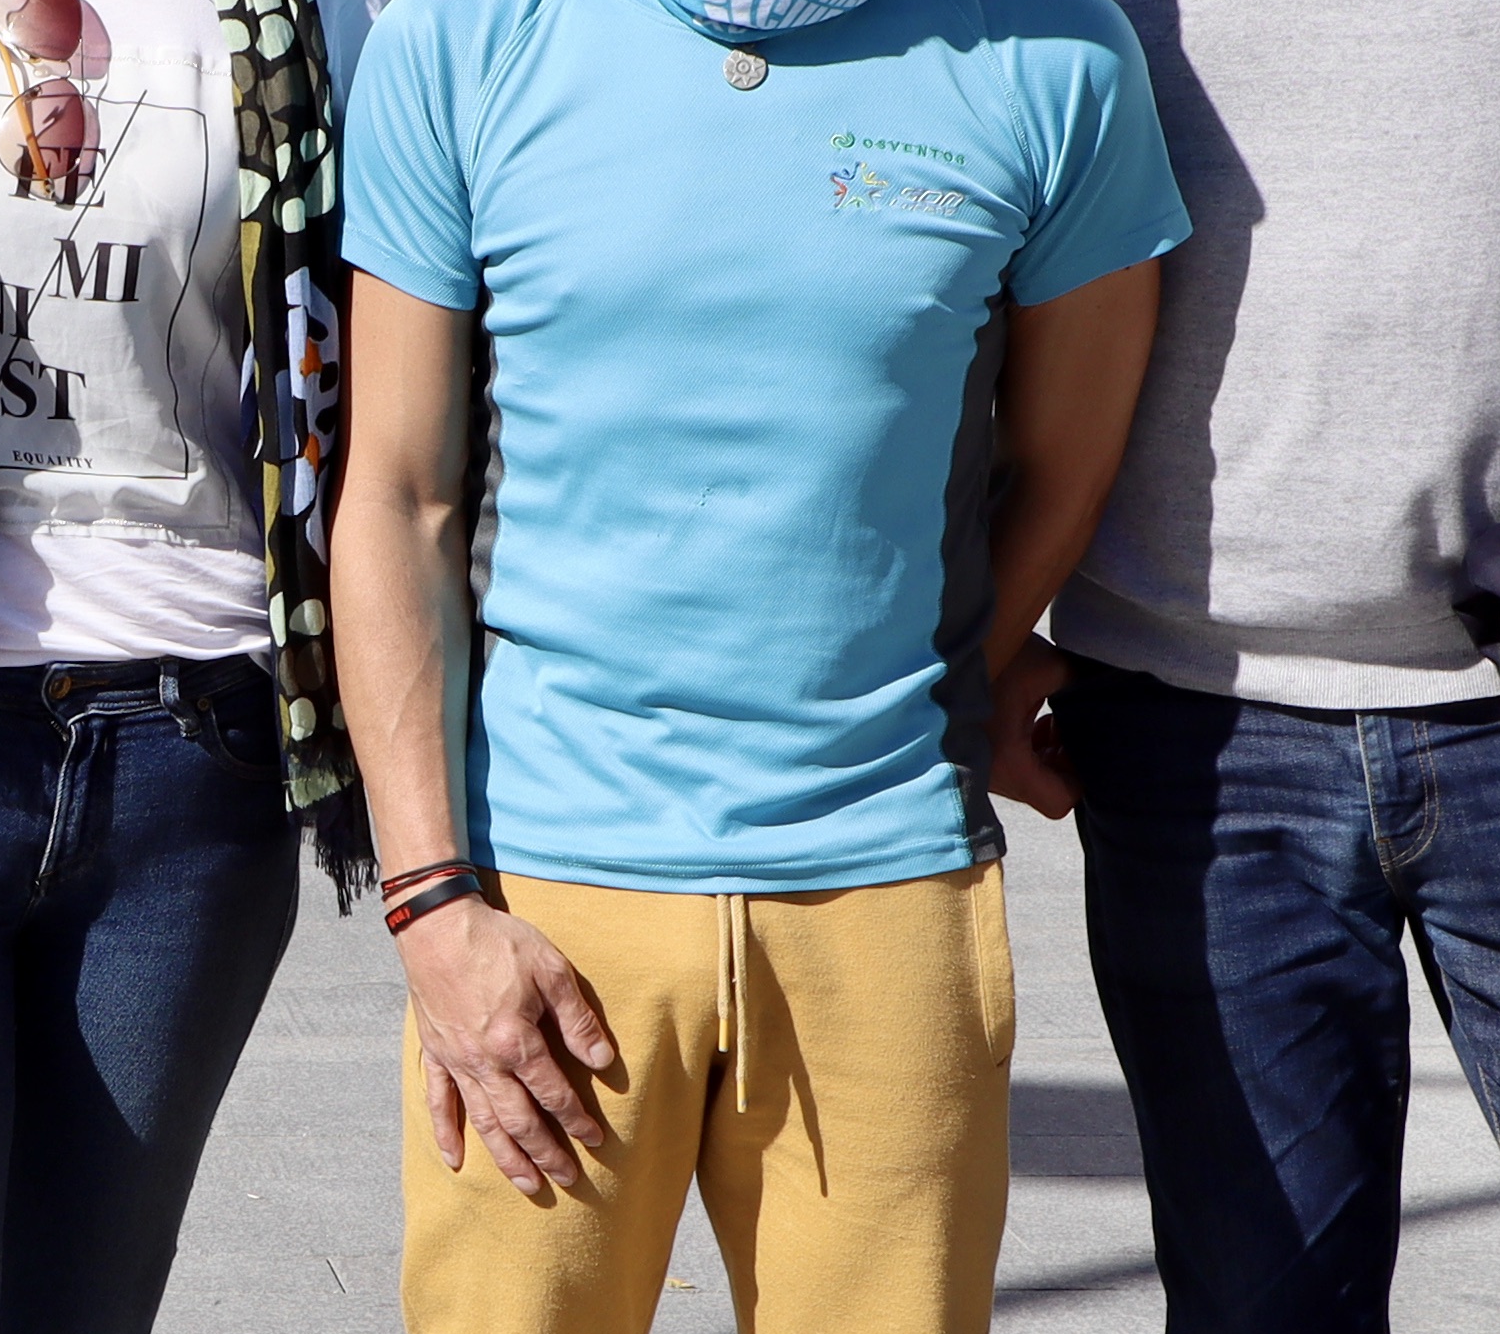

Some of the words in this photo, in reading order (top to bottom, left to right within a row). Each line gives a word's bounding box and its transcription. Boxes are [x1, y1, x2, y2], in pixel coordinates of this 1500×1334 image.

[48, 237, 148, 303] MI
[0, 358, 87, 422] ST
[12, 449, 95, 470] EQUALITY
